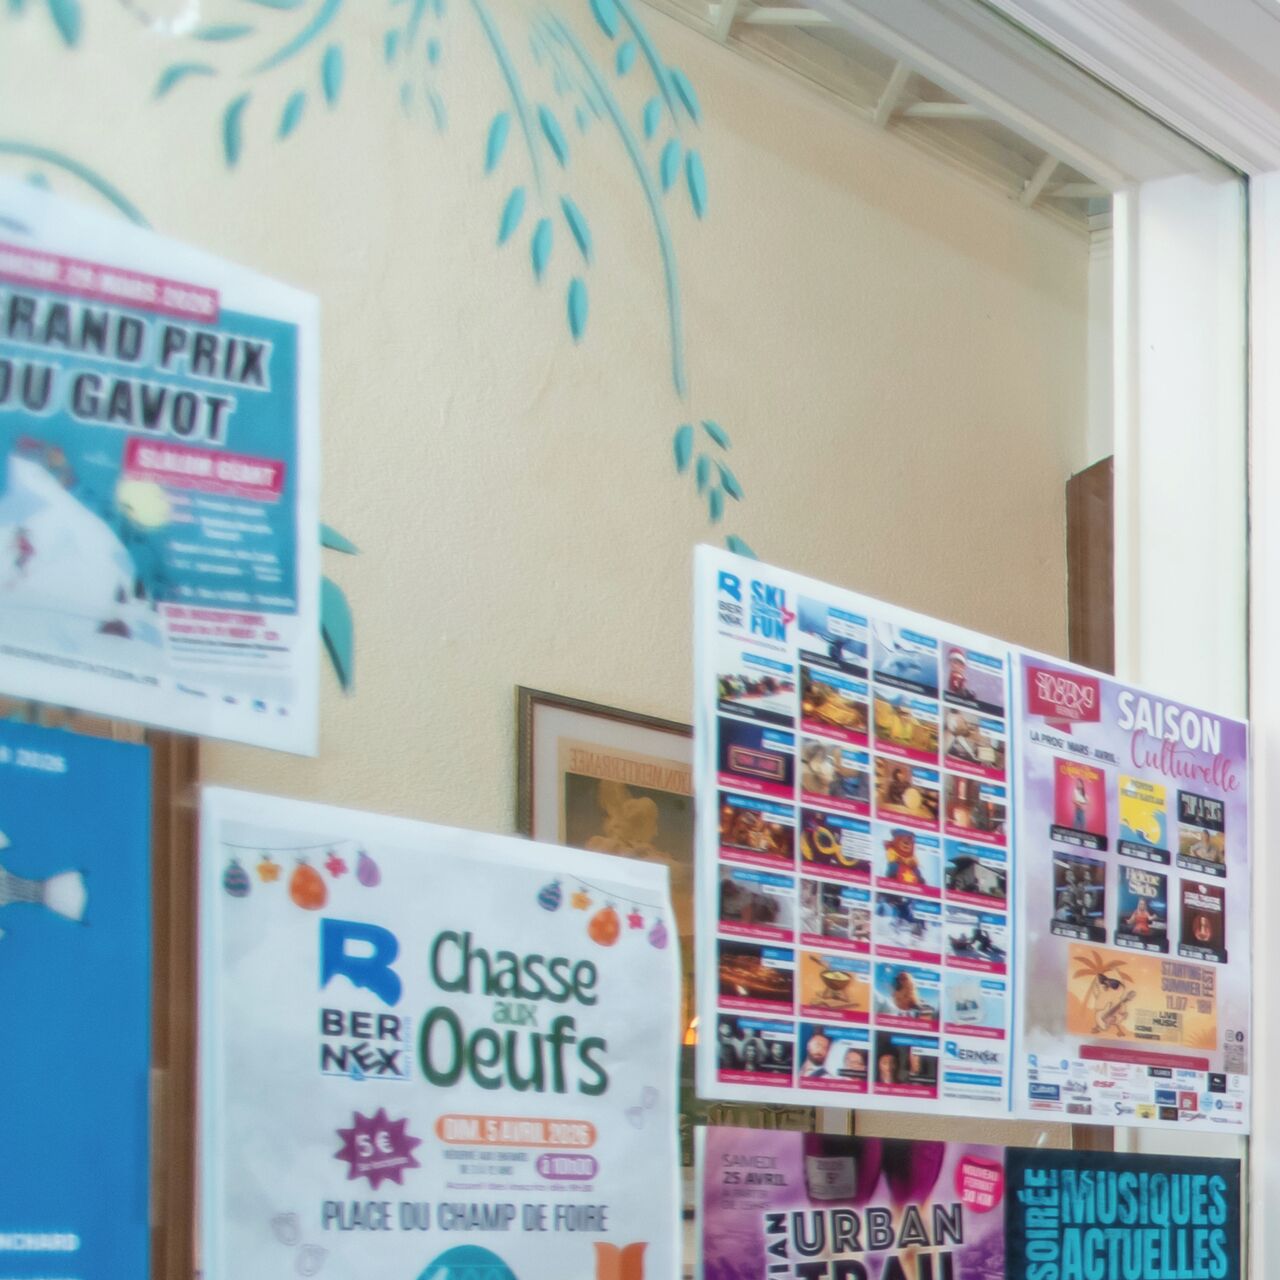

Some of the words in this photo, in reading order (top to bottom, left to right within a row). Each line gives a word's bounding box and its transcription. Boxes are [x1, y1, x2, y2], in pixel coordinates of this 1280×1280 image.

[6, 293, 146, 362] RAND
[160, 323, 268, 387] PRIX
[70, 371, 230, 441] GAVOT
[751, 580, 786, 609] SKI
[751, 614, 788, 643] FUN
[1117, 690, 1221, 756] SAISON
[1130, 729, 1240, 792] Culturelle
[429, 930, 599, 1006] Chasse
[321, 1008, 402, 1042] BER
[492, 1001, 539, 1027] aux
[321, 1043, 402, 1078] NEX
[418, 1006, 610, 1096] Oeufs
[355, 1133, 374, 1158] 5
[374, 1130, 394, 1154] €
[486, 1118, 499, 1142] 5
[745, 1171, 788, 1187] AVRIL
[321, 1200, 393, 1231] PLACE
[400, 1201, 430, 1231] DU
[437, 1202, 517, 1232] CHAMP
[522, 1203, 548, 1232] DE
[554, 1203, 609, 1232] FOIRE
[1061, 1168, 1228, 1229] MUSIQUES
[791, 1202, 964, 1257] URBAN
